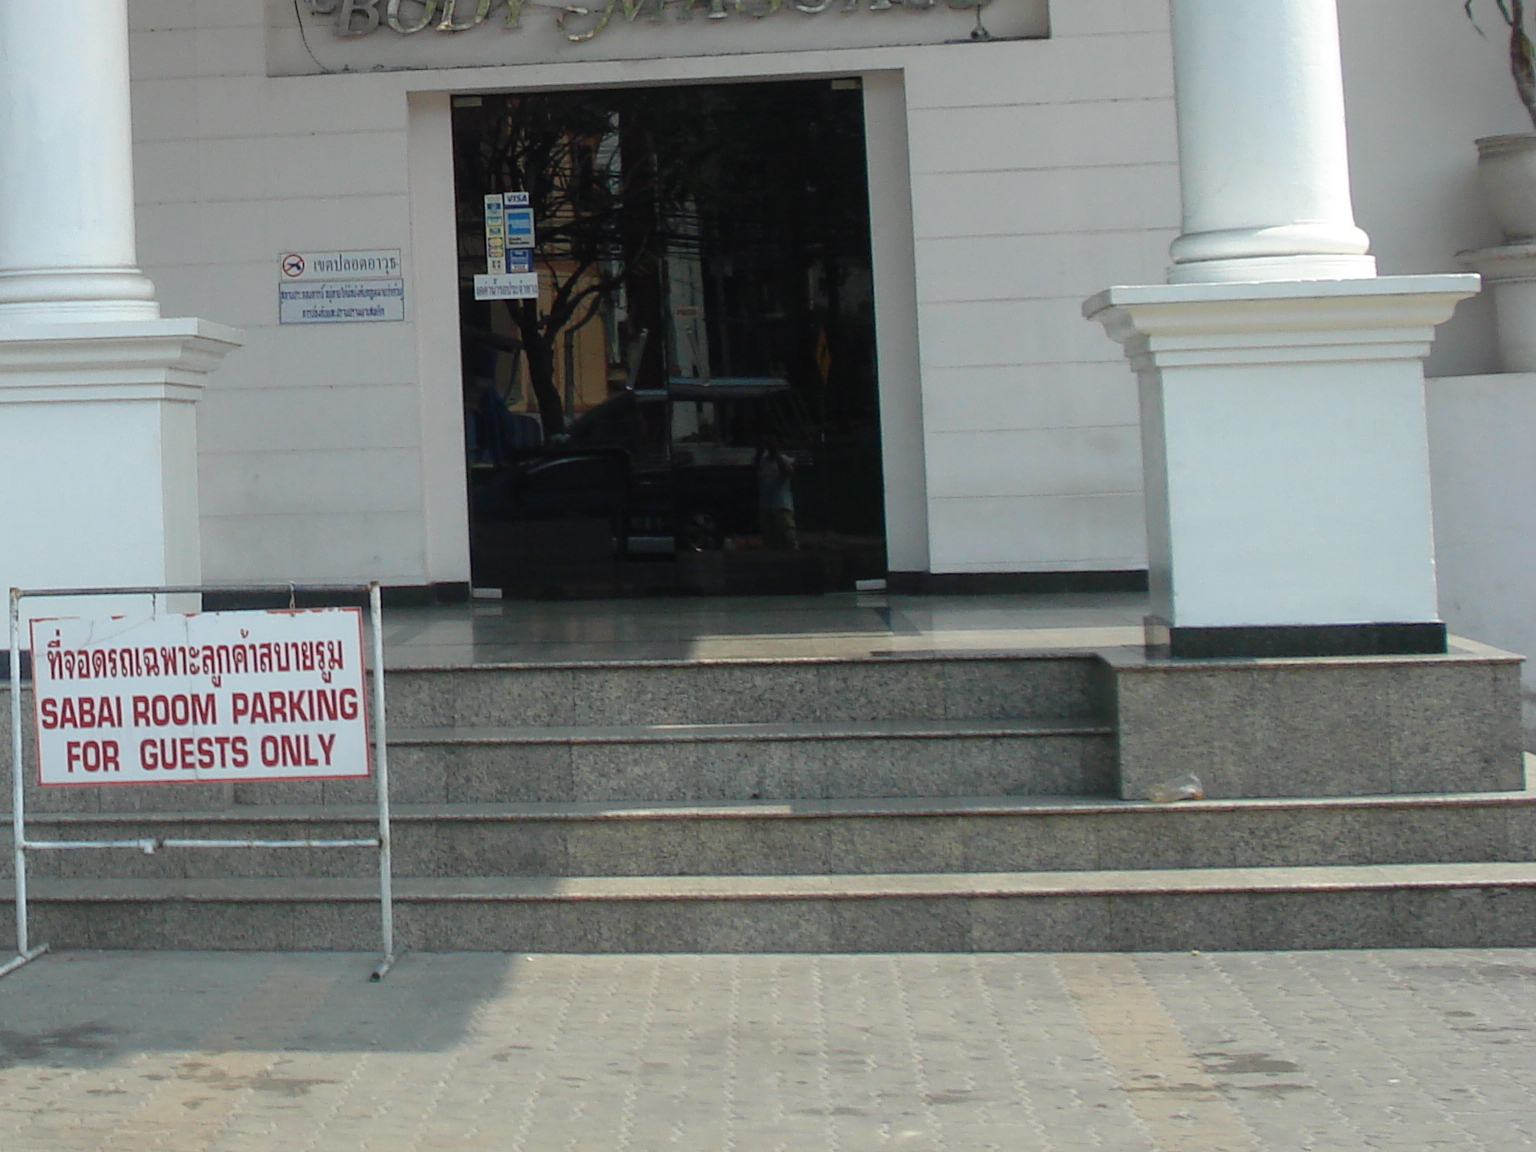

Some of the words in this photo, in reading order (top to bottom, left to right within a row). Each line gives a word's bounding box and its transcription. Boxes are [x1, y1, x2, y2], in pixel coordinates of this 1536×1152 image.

[506, 195, 528, 203] VISA
[41, 696, 123, 729] SABAI
[132, 693, 217, 727] ROOM
[232, 688, 359, 725] PARKING
[67, 740, 120, 772] FOR
[140, 736, 249, 770] GUESTS
[260, 733, 337, 766] ONLY
